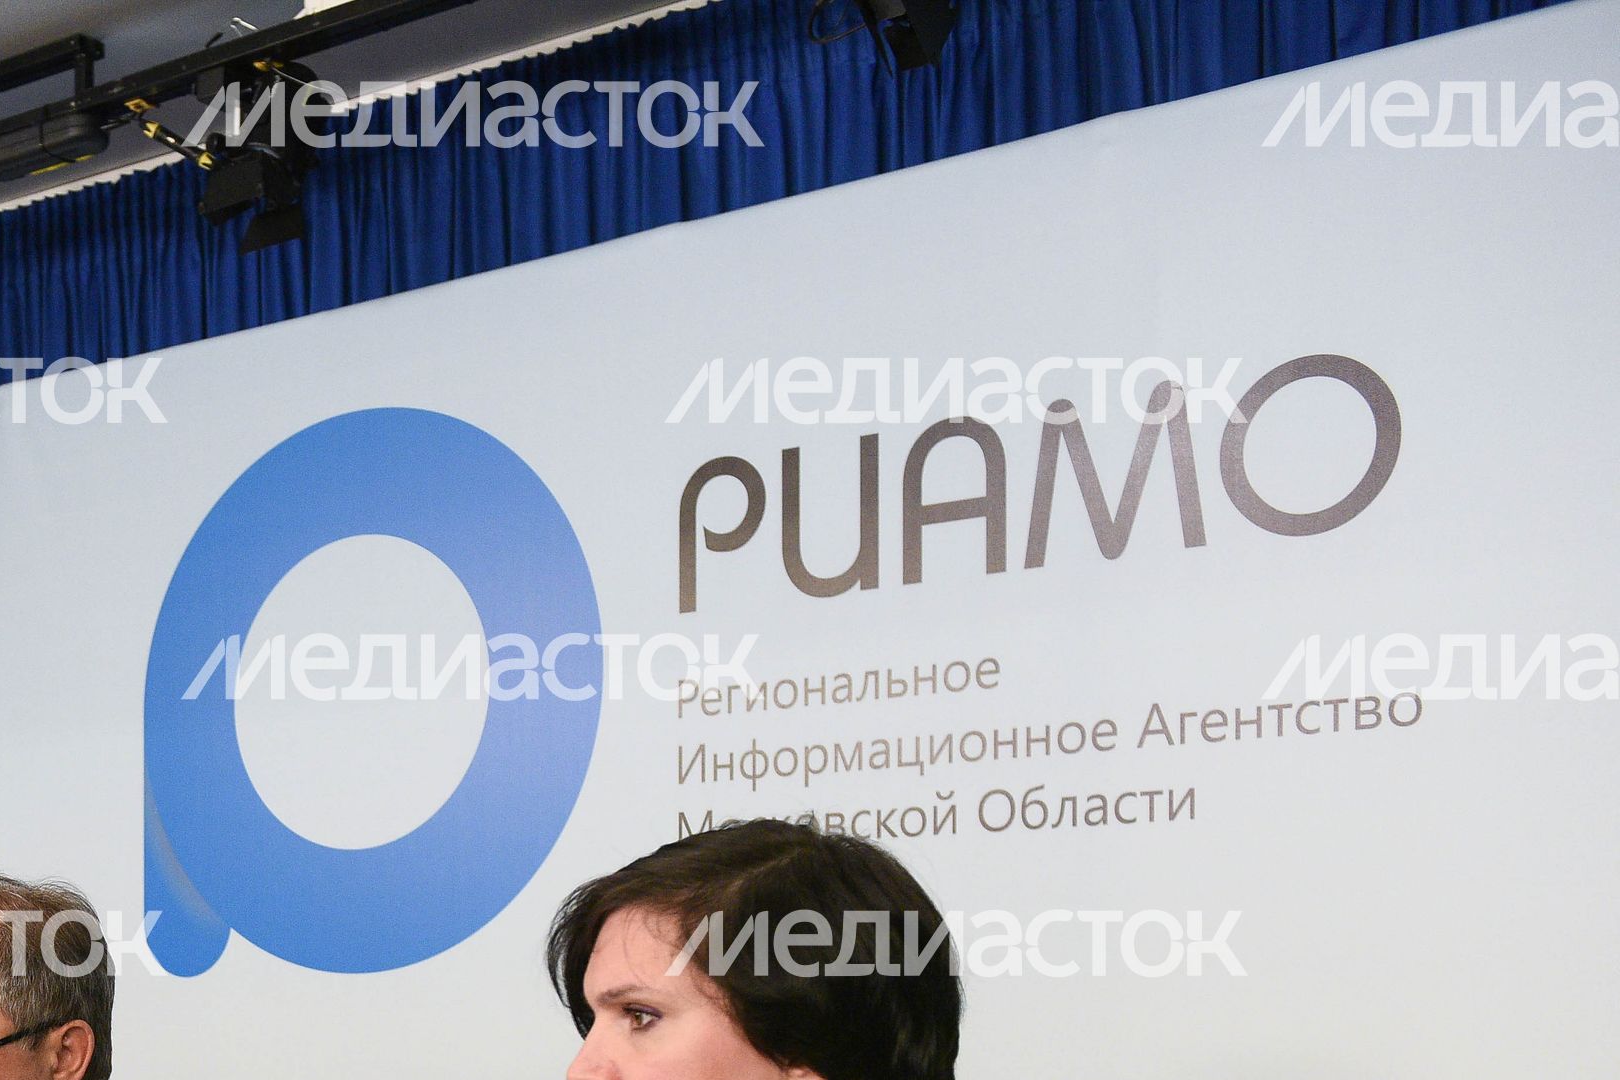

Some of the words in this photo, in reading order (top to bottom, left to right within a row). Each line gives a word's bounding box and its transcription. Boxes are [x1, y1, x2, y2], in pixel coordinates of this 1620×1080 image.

[678, 353, 1402, 613] РИАМО
[677, 654, 1002, 719] Региональное
[677, 716, 1119, 792] Информационное
[1137, 688, 1424, 749] Агентство
[978, 784, 1198, 832] Области
